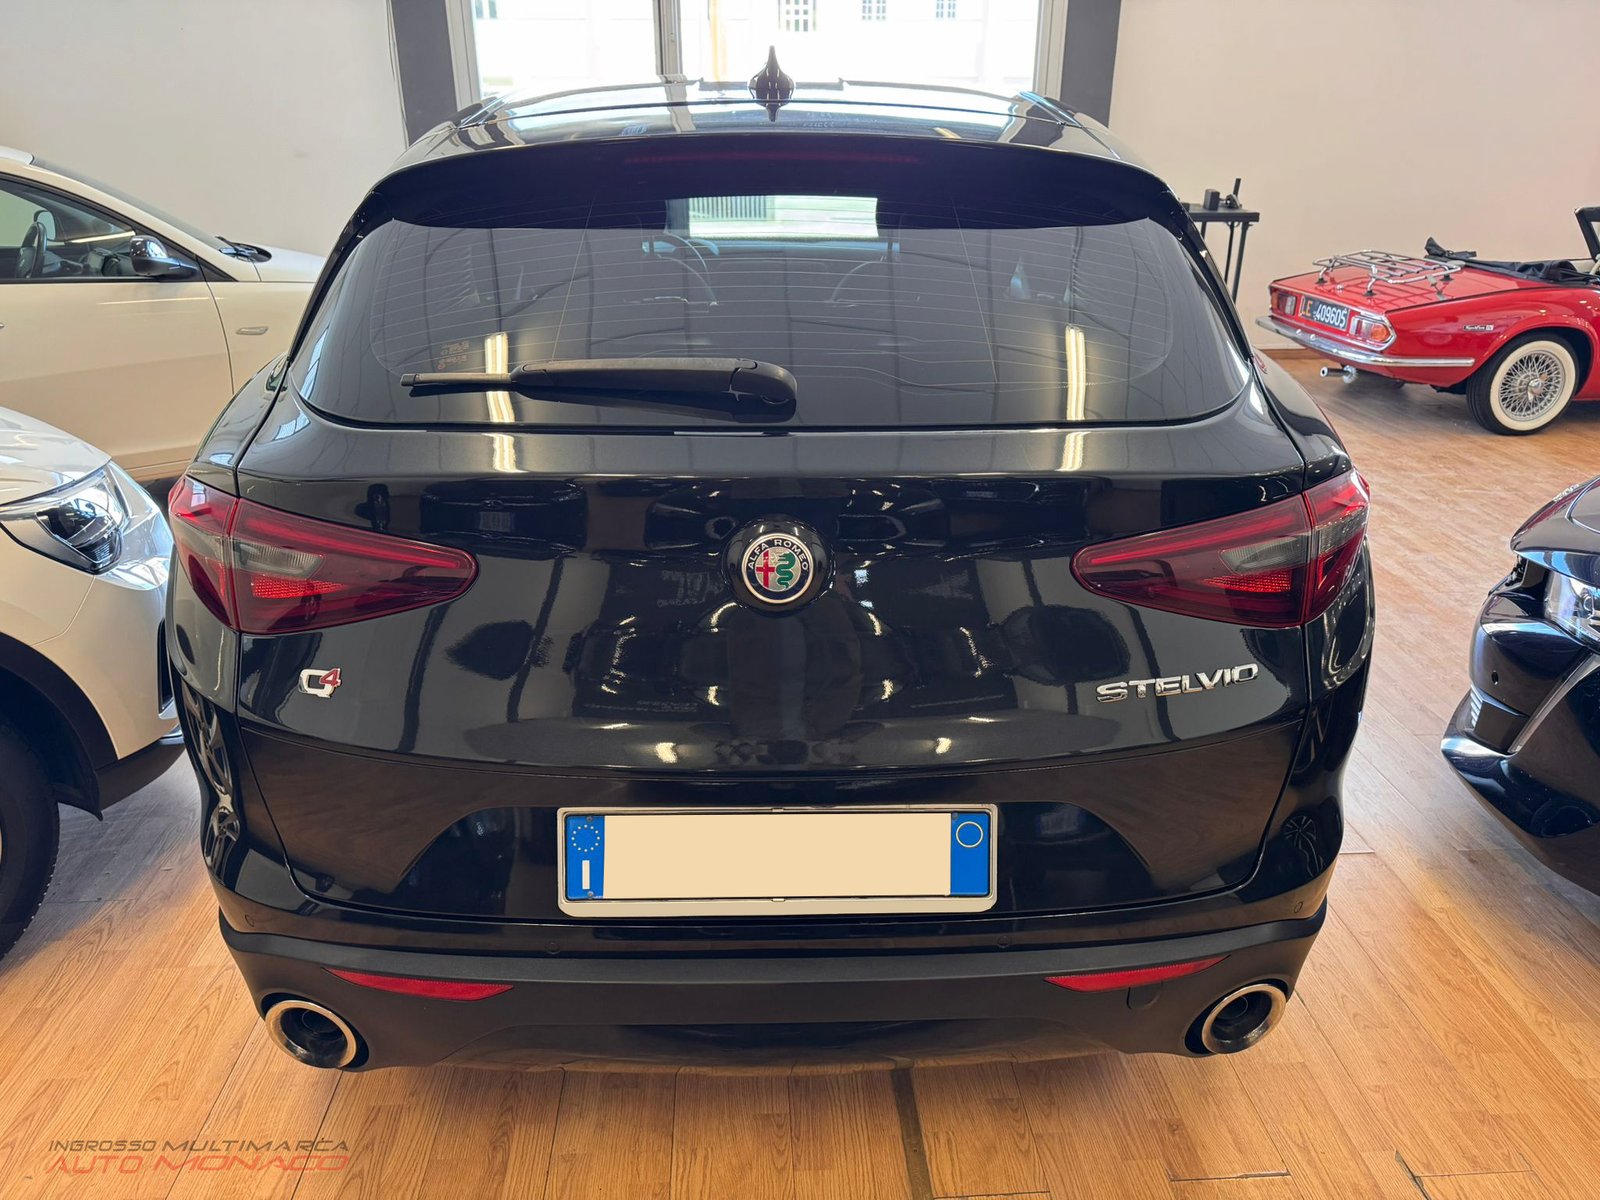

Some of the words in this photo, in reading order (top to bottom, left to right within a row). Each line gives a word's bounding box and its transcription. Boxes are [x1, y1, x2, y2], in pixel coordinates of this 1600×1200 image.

[1315, 303, 1348, 329] 409605
[747, 542, 769, 570] ALFA
[773, 539, 809, 571] ROMEO
[1096, 663, 1259, 703] STELVIO
